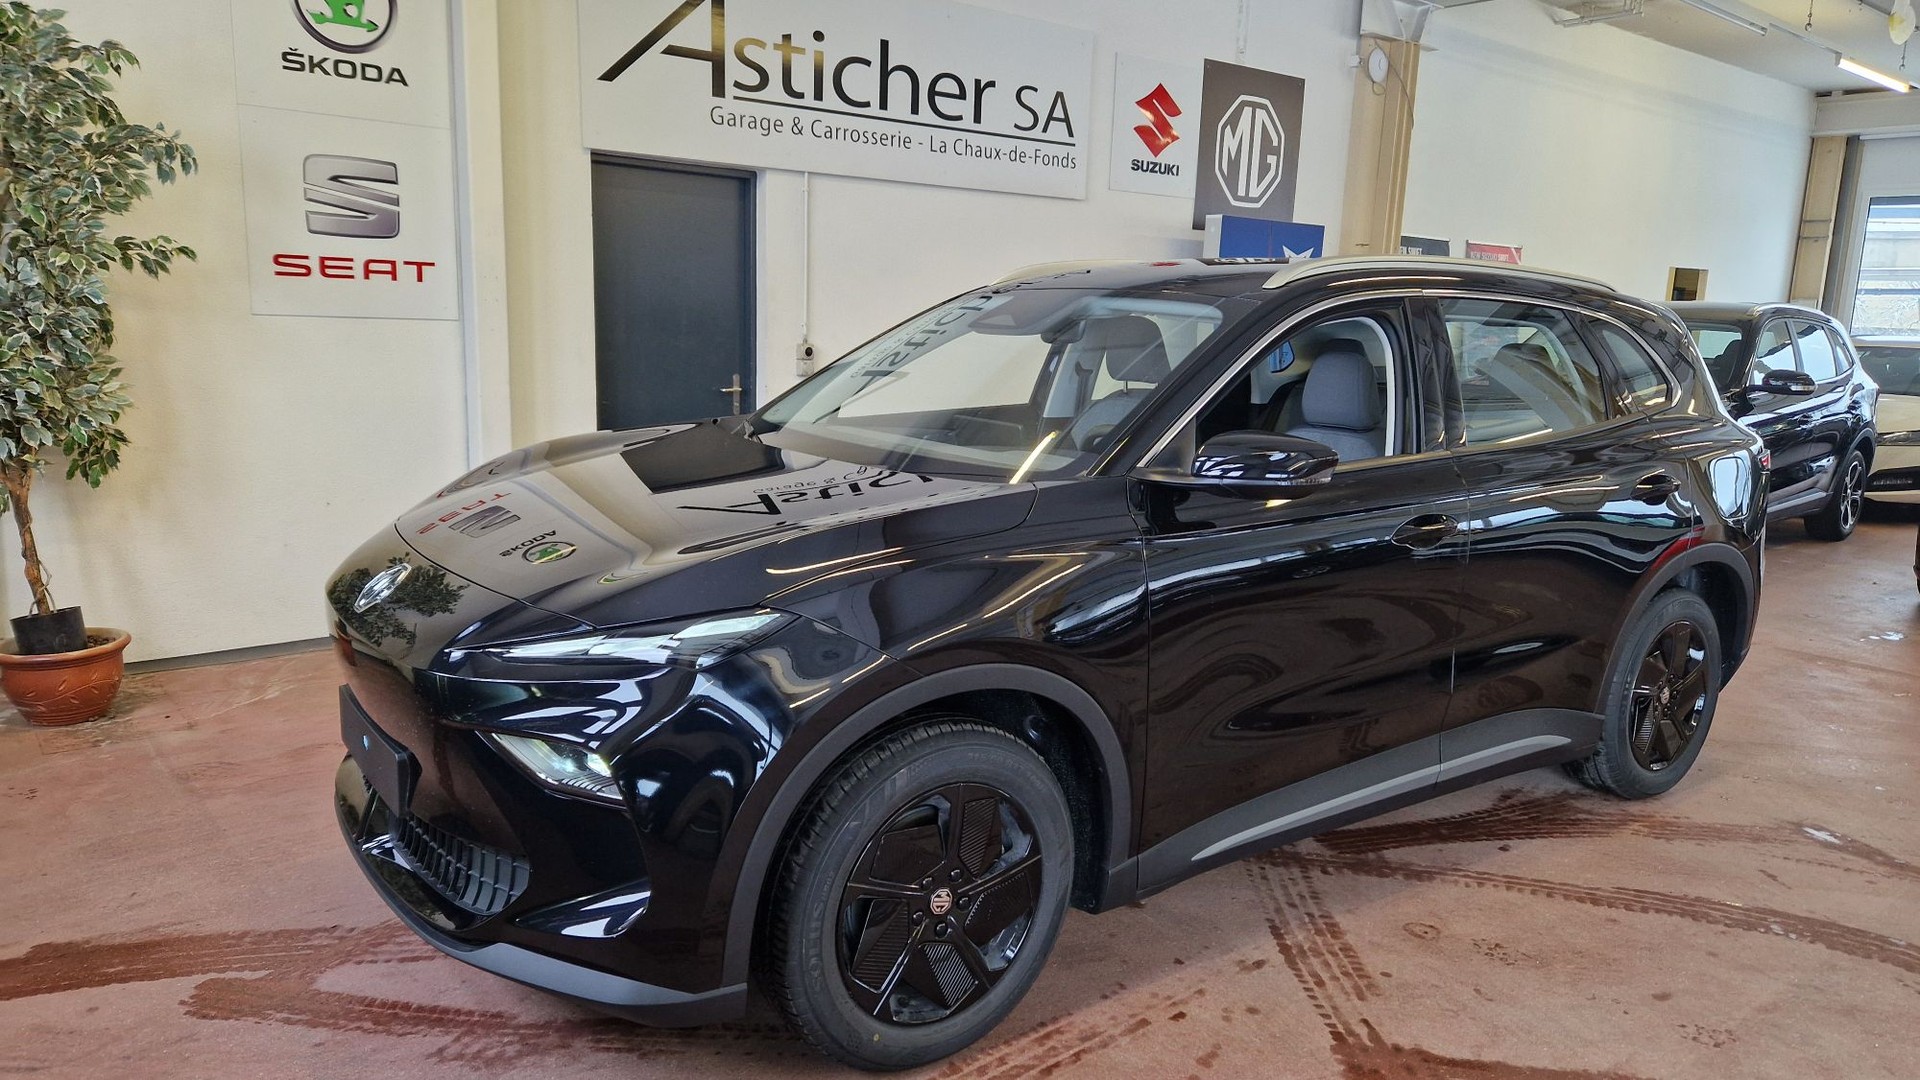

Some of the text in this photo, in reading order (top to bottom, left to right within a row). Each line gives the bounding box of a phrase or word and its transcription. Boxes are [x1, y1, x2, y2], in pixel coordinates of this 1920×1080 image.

[281, 47, 409, 87] ŠKODA
[597, 0, 1075, 138] Asticher SA
[709, 106, 784, 136] Garage
[791, 116, 804, 135] &
[811, 118, 912, 151] Carrosserie
[930, 135, 947, 154] La
[953, 139, 1077, 170] Chaux-de-Fonds
[1221, 105, 1279, 198] MG
[1131, 159, 1180, 177] SUZUKI
[272, 253, 435, 283] SEAT
